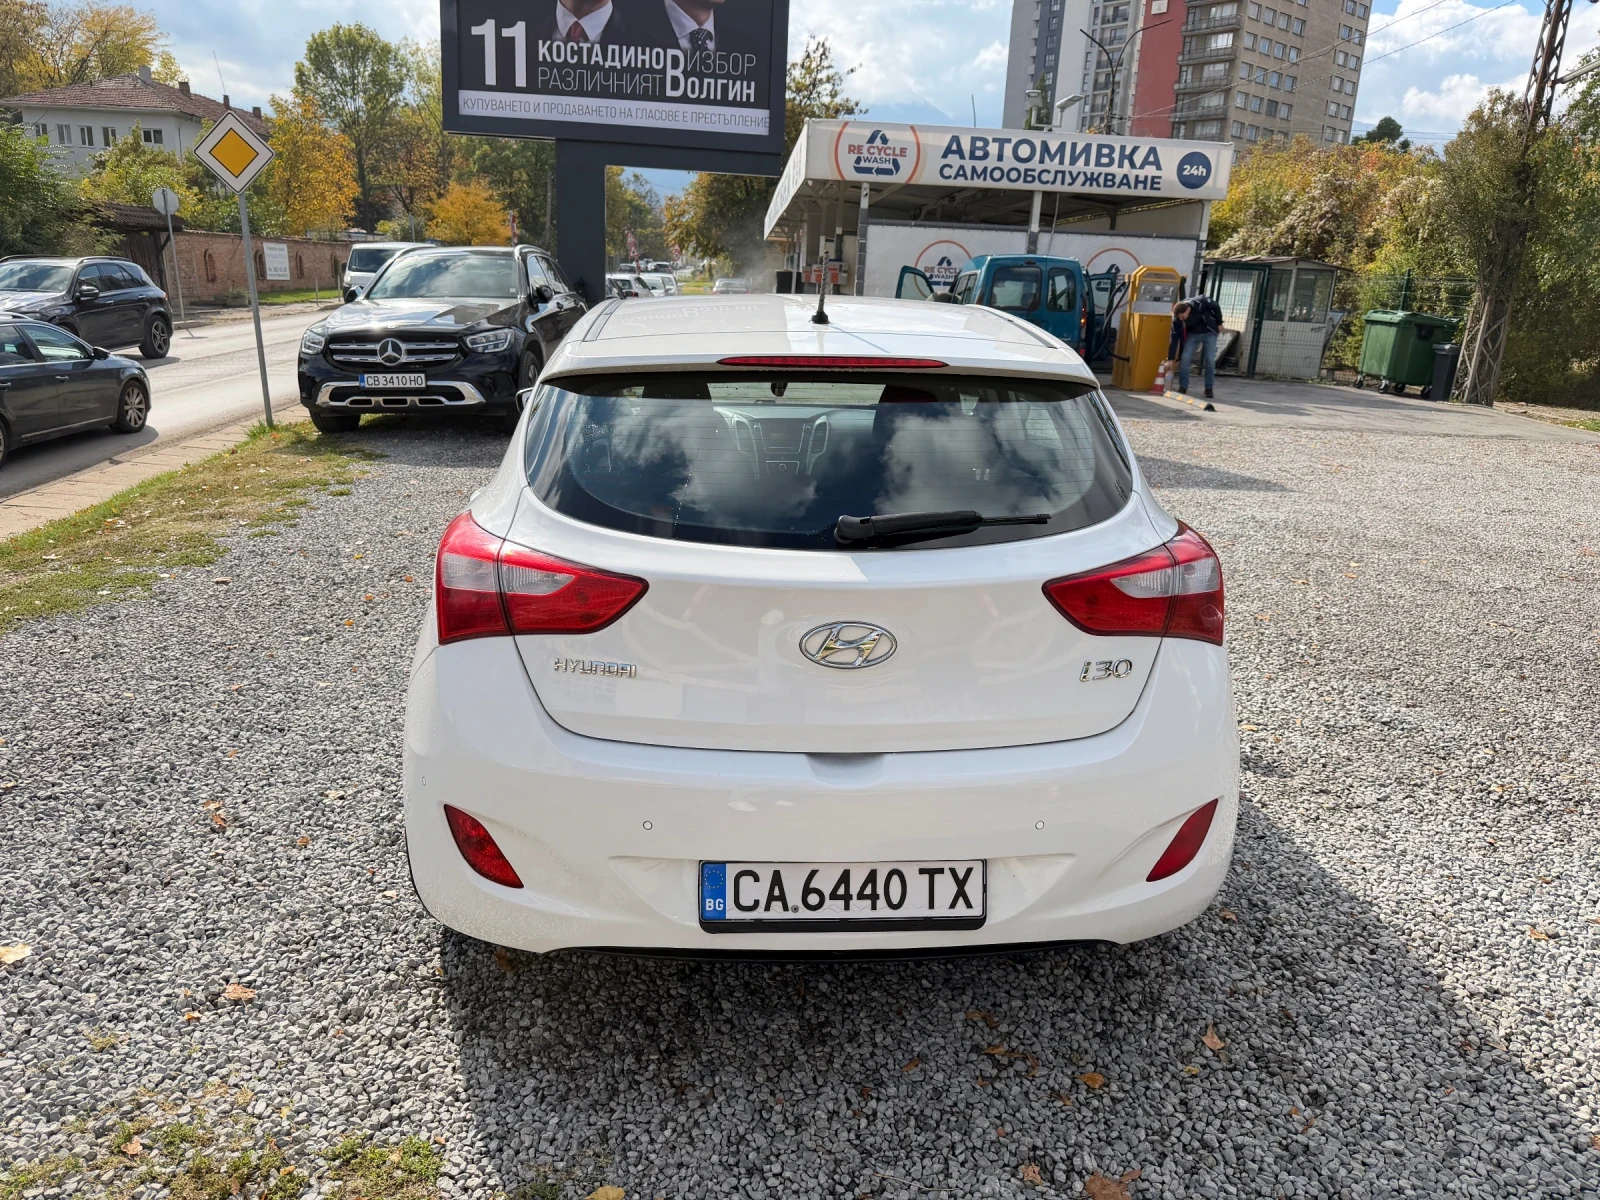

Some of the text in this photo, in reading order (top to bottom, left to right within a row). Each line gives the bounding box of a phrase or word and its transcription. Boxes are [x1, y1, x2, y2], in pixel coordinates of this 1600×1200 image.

[471, 19, 527, 88] 11
[687, 50, 757, 76] ИЗБОР
[538, 67, 664, 97] РАЗЛИЧНИЯТ
[463, 97, 769, 129] КУПУВАНЕТО И ПРОДАВАНЕТО НА ГЛАСОВЕ Е ПРЕСТЪПЛЕНИЕ
[847, 144, 908, 158] RE CYCLE
[862, 155, 891, 165] WASH
[940, 134, 1163, 172] АВТОМИВКА
[938, 163, 1163, 191] САМООБСЛУЖВАНЕ
[1182, 163, 1207, 177] 24h
[924, 265, 962, 275] RE CYCL
[366, 375, 380, 387] CB
[382, 375, 408, 387] 3410
[554, 657, 637, 679] HYUNDAI
[1079, 657, 1133, 682] i30
[705, 867, 974, 912] BG CA 6440 TX
